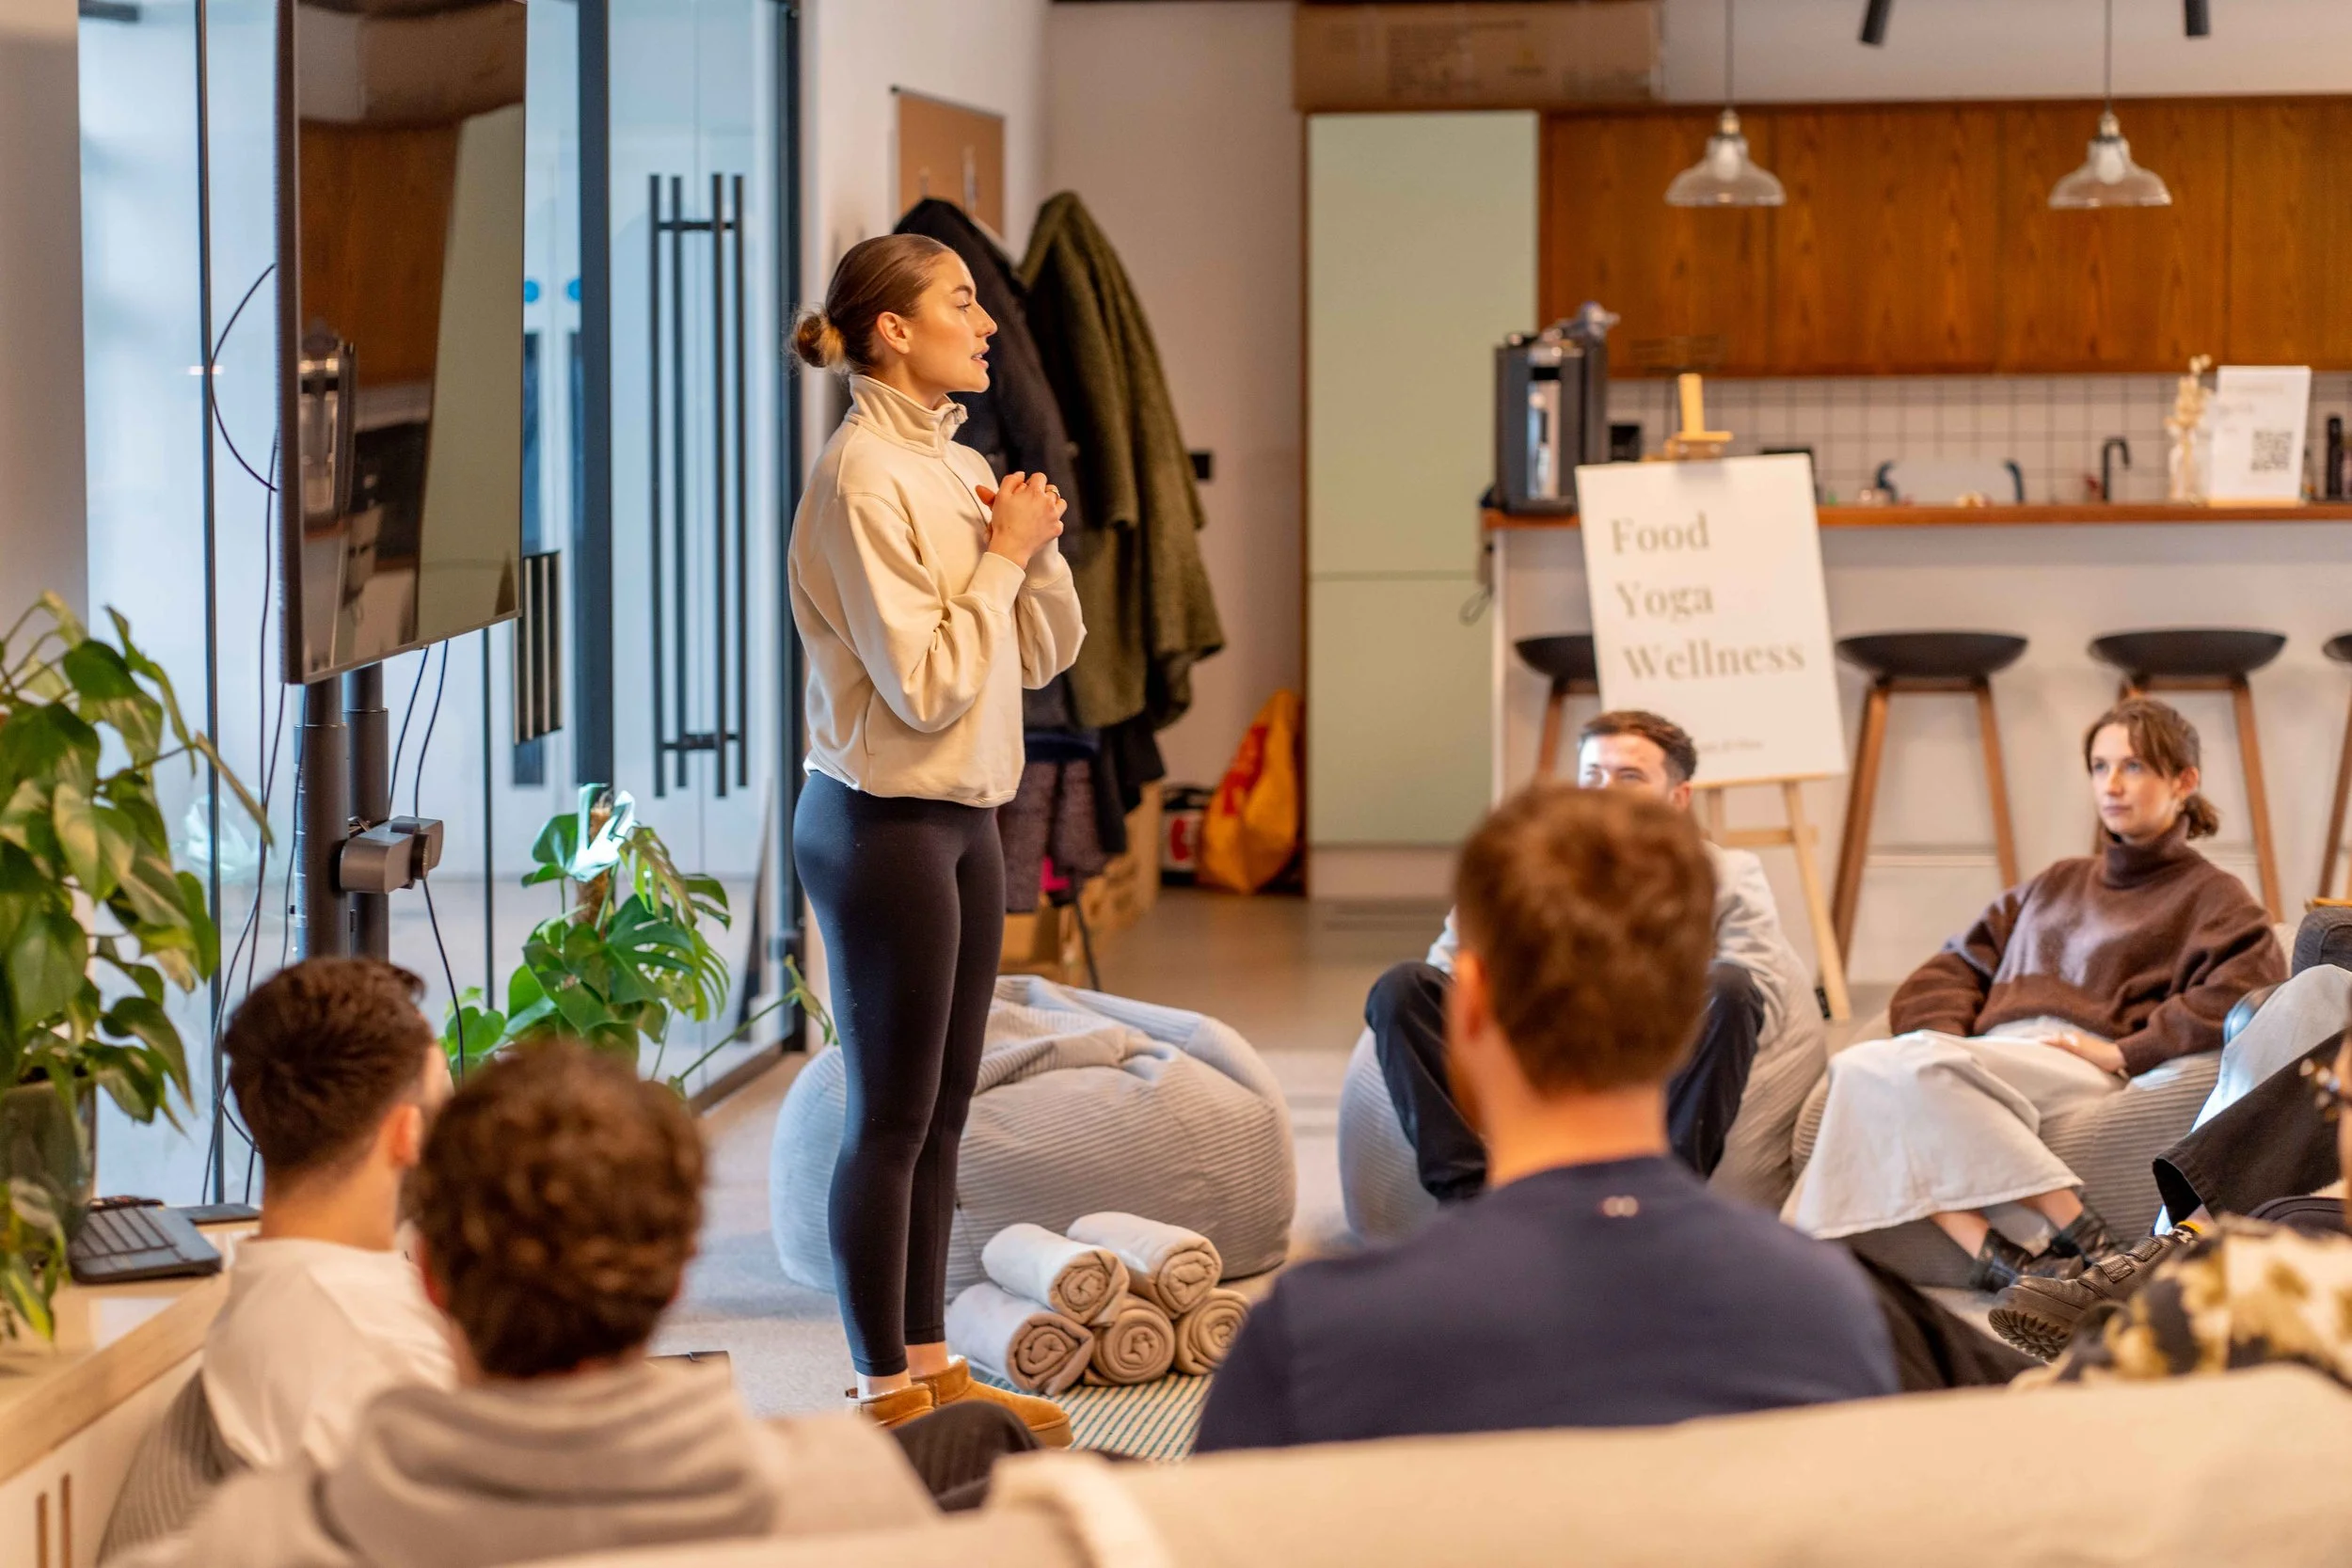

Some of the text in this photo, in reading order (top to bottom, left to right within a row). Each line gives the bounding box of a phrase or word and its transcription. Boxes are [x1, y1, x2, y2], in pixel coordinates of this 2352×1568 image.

[1611, 512, 1709, 554] Food
[1616, 581, 1715, 623] Yoga
[1623, 639, 1806, 680] Wellness
